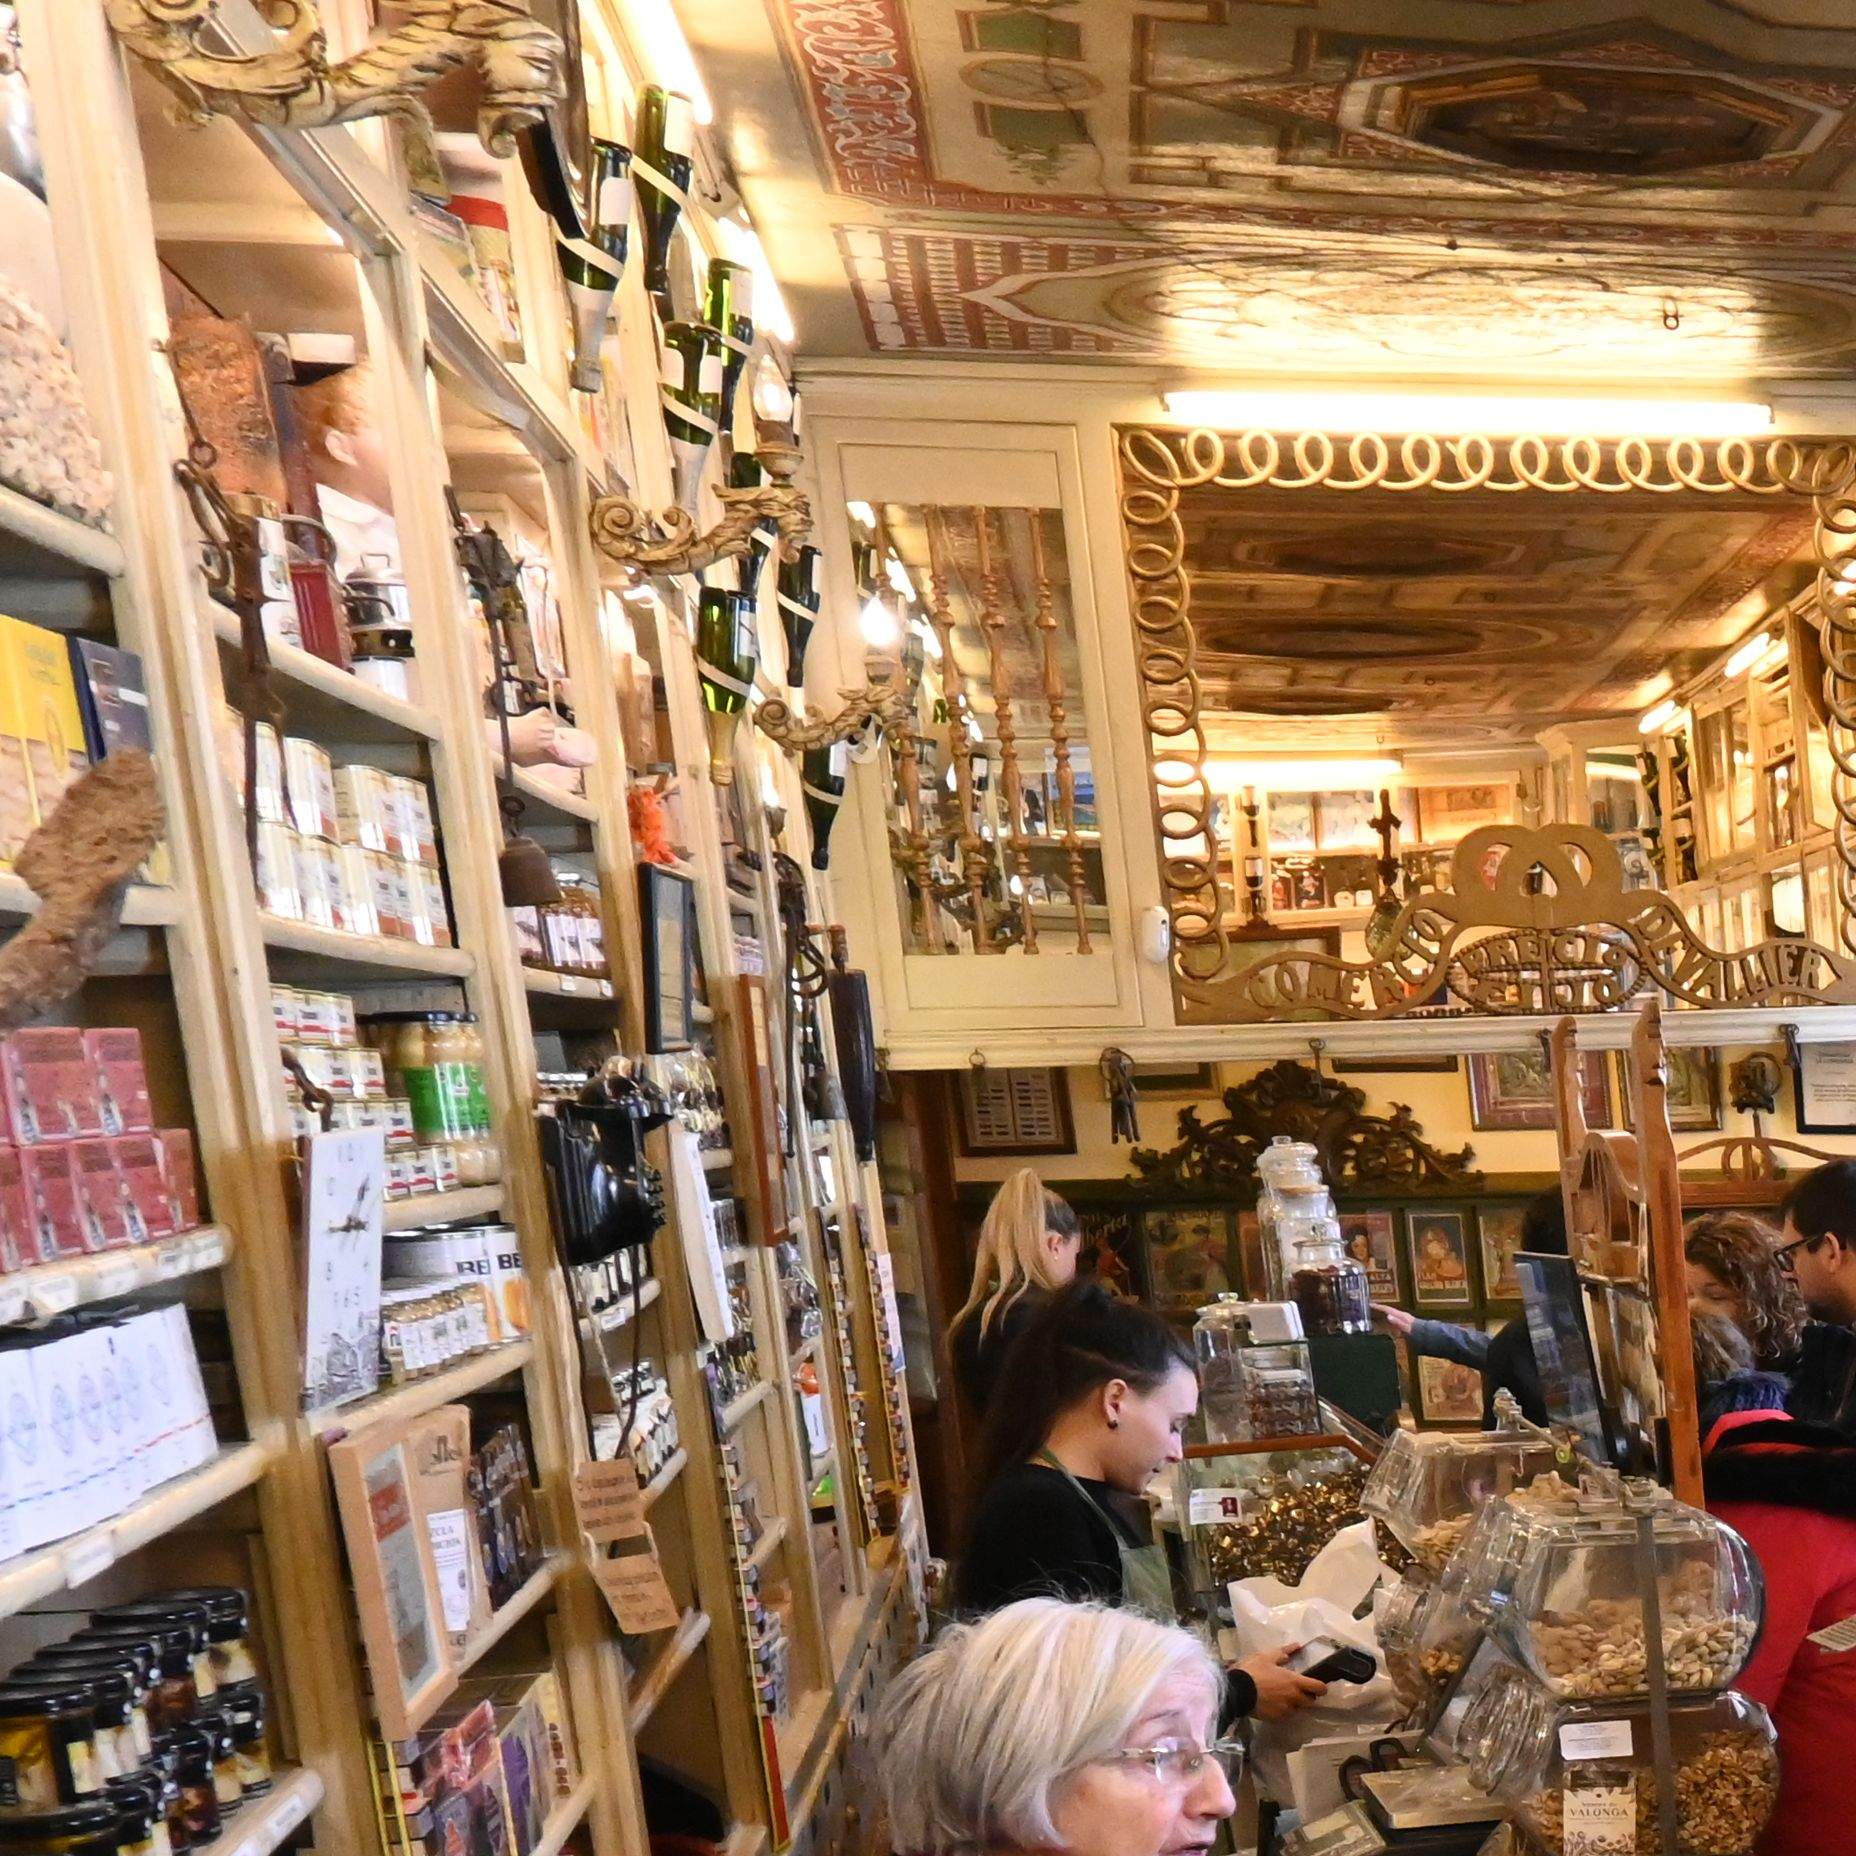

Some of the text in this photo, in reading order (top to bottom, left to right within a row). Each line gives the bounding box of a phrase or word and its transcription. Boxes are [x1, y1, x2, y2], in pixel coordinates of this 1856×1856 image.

[1247, 907, 1444, 1013] COMERCIO
[1459, 933, 1627, 974] PRECIO
[1670, 944, 1824, 1002] VALLIER
[1473, 974, 1622, 1010] FIJO
[1569, 1806, 1629, 1818] VALONGA
